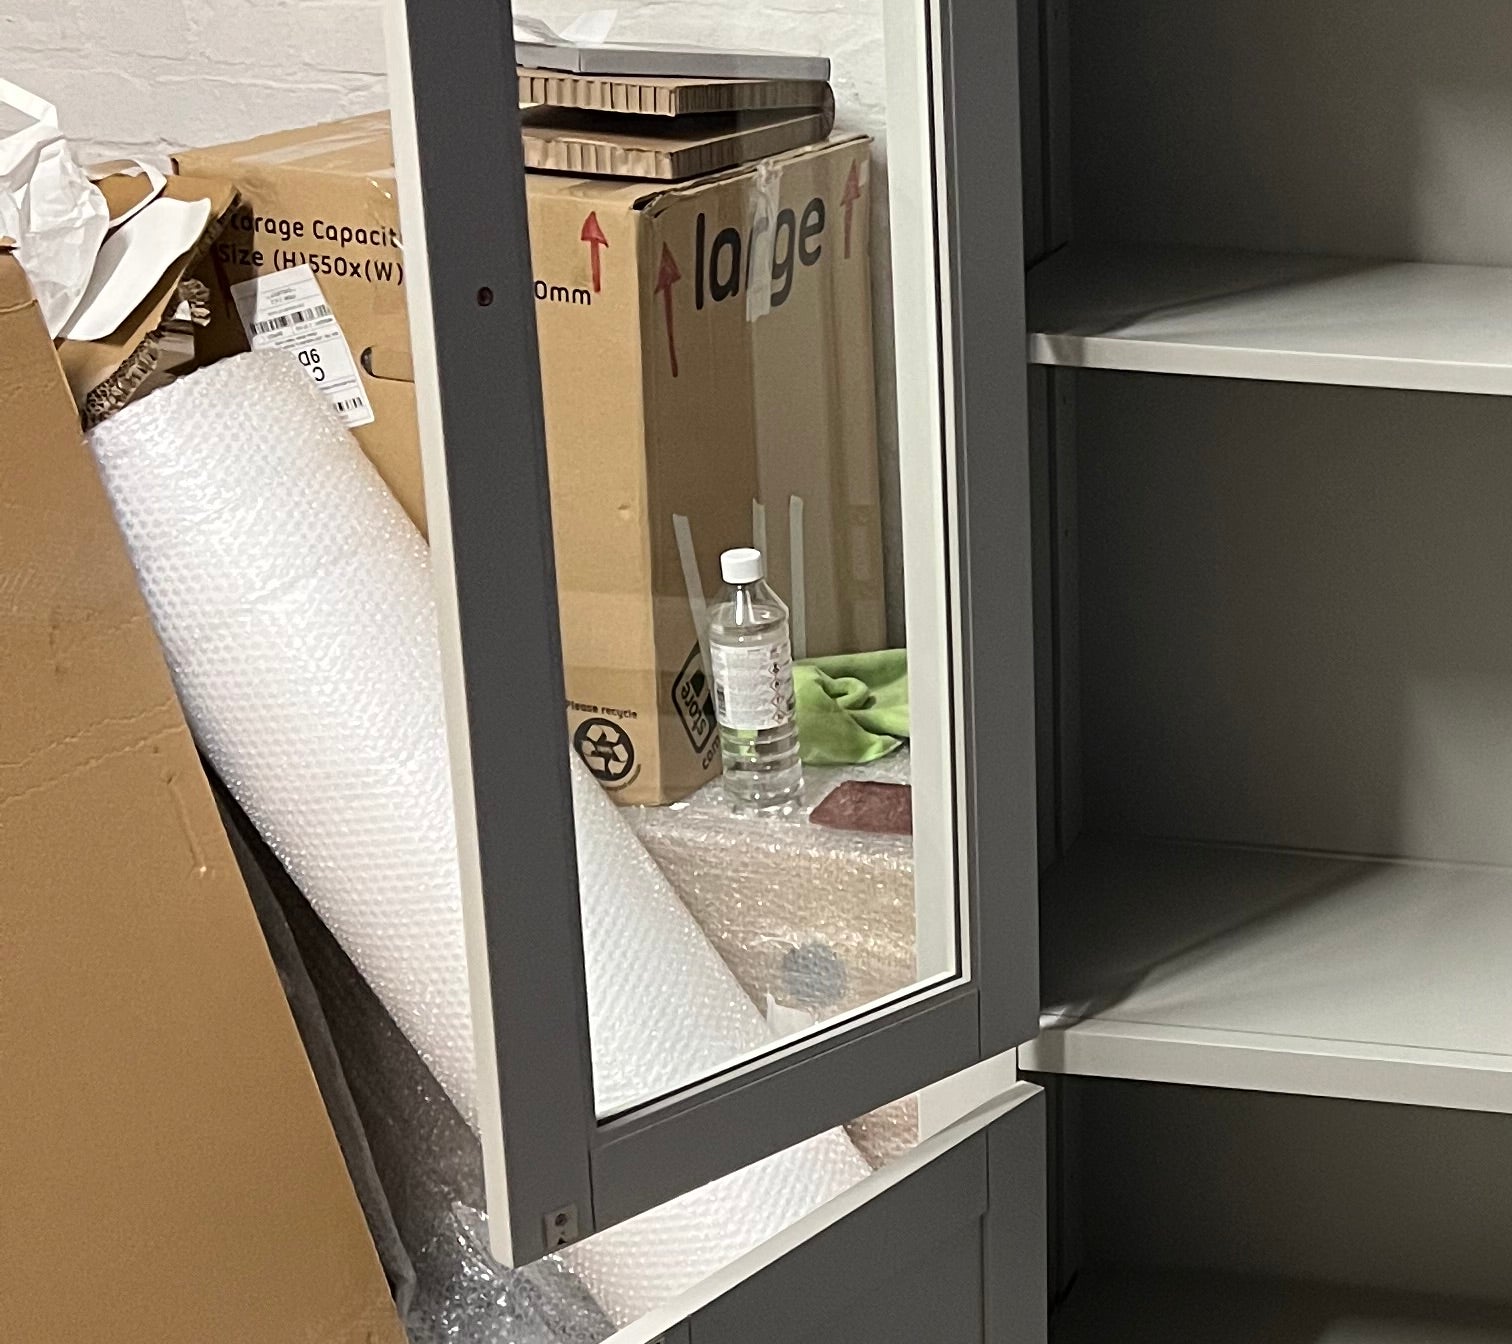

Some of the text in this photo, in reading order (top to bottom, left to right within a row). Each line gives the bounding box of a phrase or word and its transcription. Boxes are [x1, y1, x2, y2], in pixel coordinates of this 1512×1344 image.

[230, 213, 304, 242] torage
[217, 243, 264, 267] Size
[601, 706, 638, 720] recycle
[680, 681, 708, 737] store
